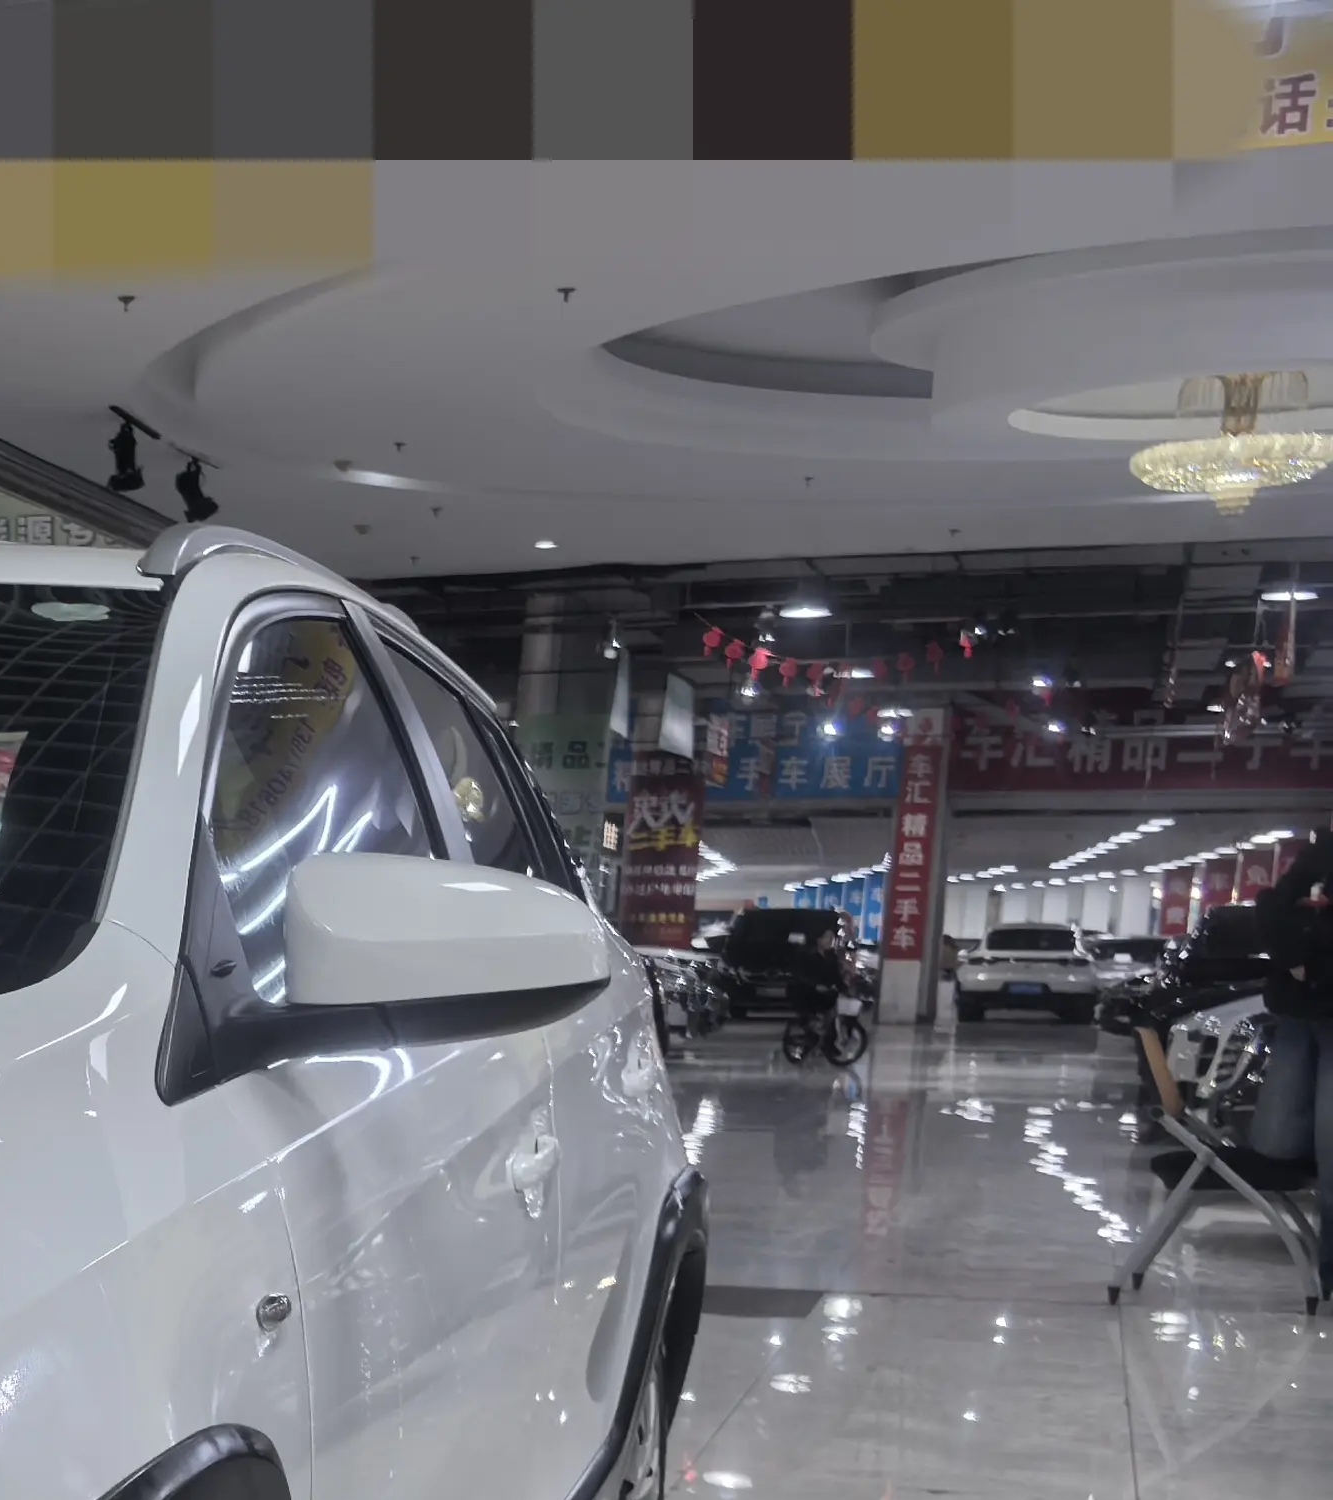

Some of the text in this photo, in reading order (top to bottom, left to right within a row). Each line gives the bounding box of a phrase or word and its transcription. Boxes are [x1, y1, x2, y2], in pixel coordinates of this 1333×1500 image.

[890, 753, 933, 950] 车汇精品二手车
